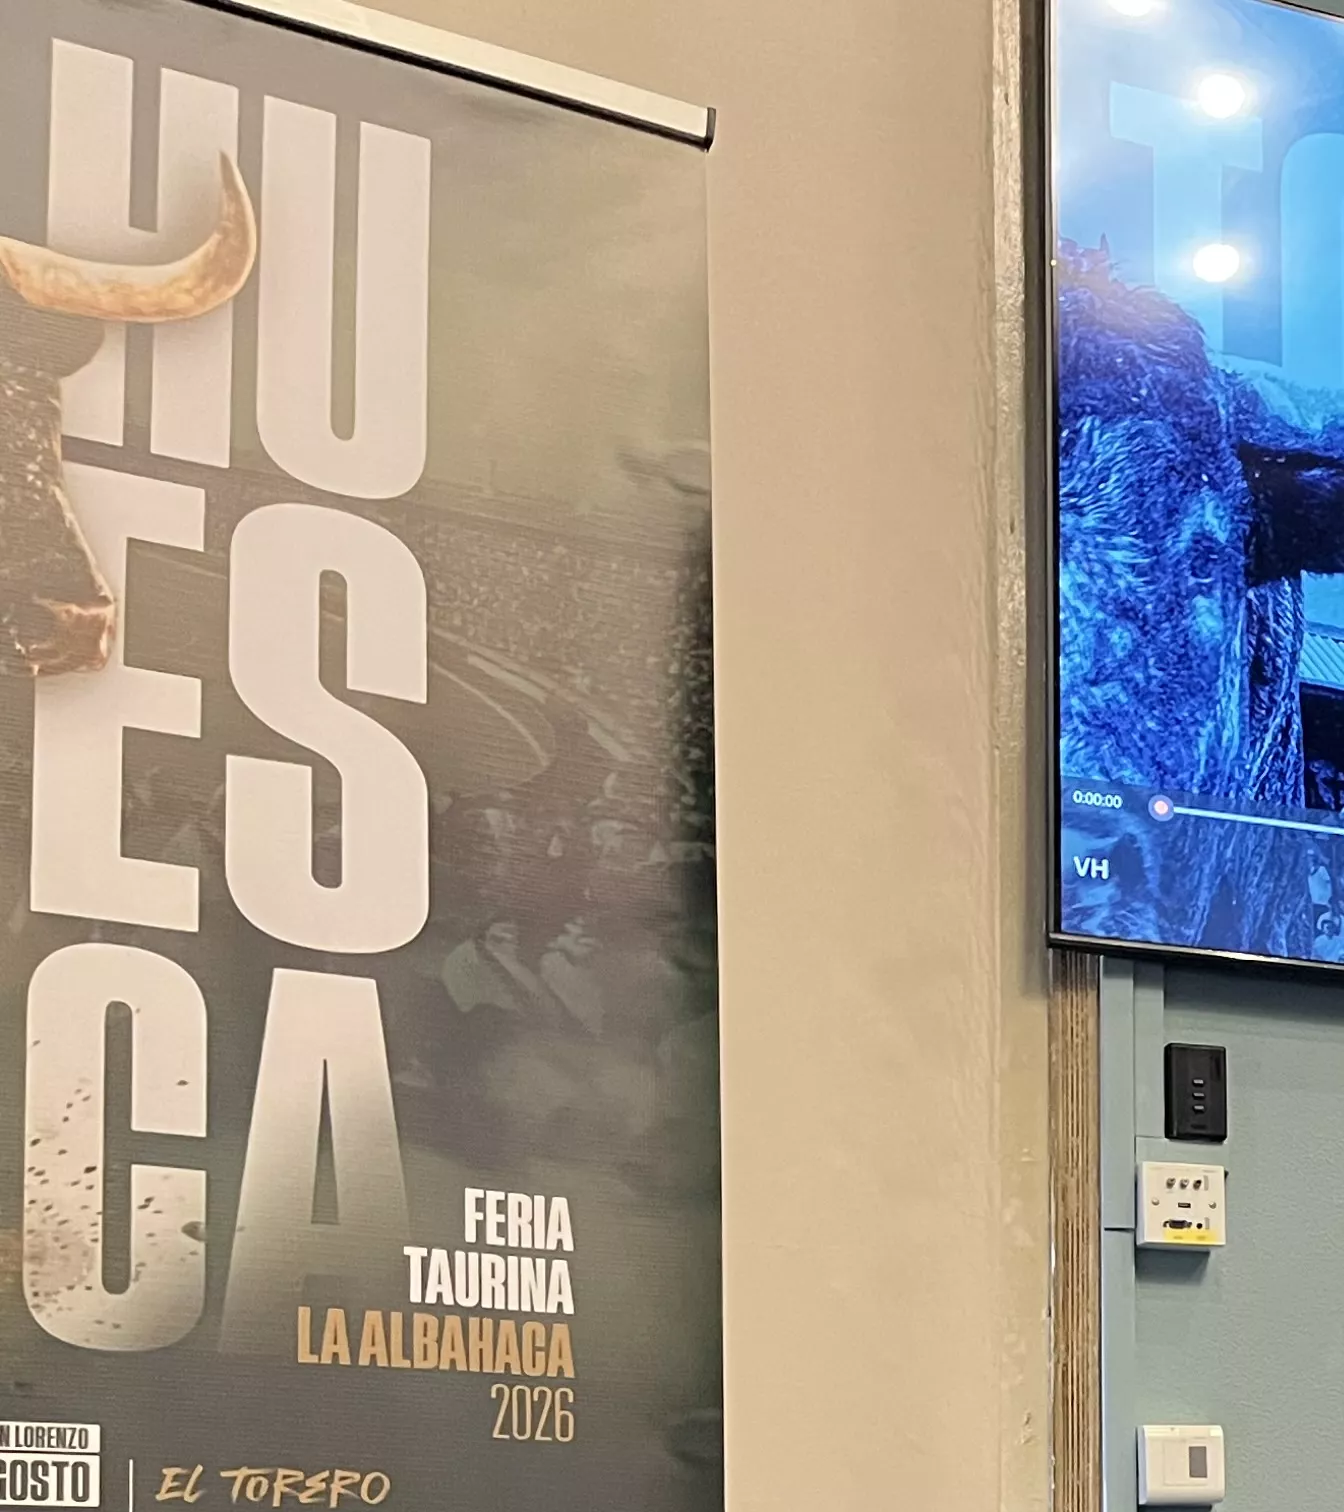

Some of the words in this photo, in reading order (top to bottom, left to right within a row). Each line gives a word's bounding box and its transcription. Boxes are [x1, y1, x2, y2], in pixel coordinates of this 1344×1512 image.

[47, 37, 431, 500] HU
[30, 460, 429, 954] ES
[1073, 790, 1123, 809] 0:00:00
[1073, 856, 1109, 880] VH
[22, 942, 415, 1353] CA
[463, 1186, 574, 1252] FERIA
[404, 1246, 575, 1315] TAURINA
[297, 1306, 351, 1366] LA
[358, 1310, 575, 1379] ALBAHACA
[15, 1425, 89, 1449] LORENZO
[490, 1383, 575, 1442] 2026
[154, 1464, 204, 1504] EL
[221, 1466, 392, 1508] TORERO
